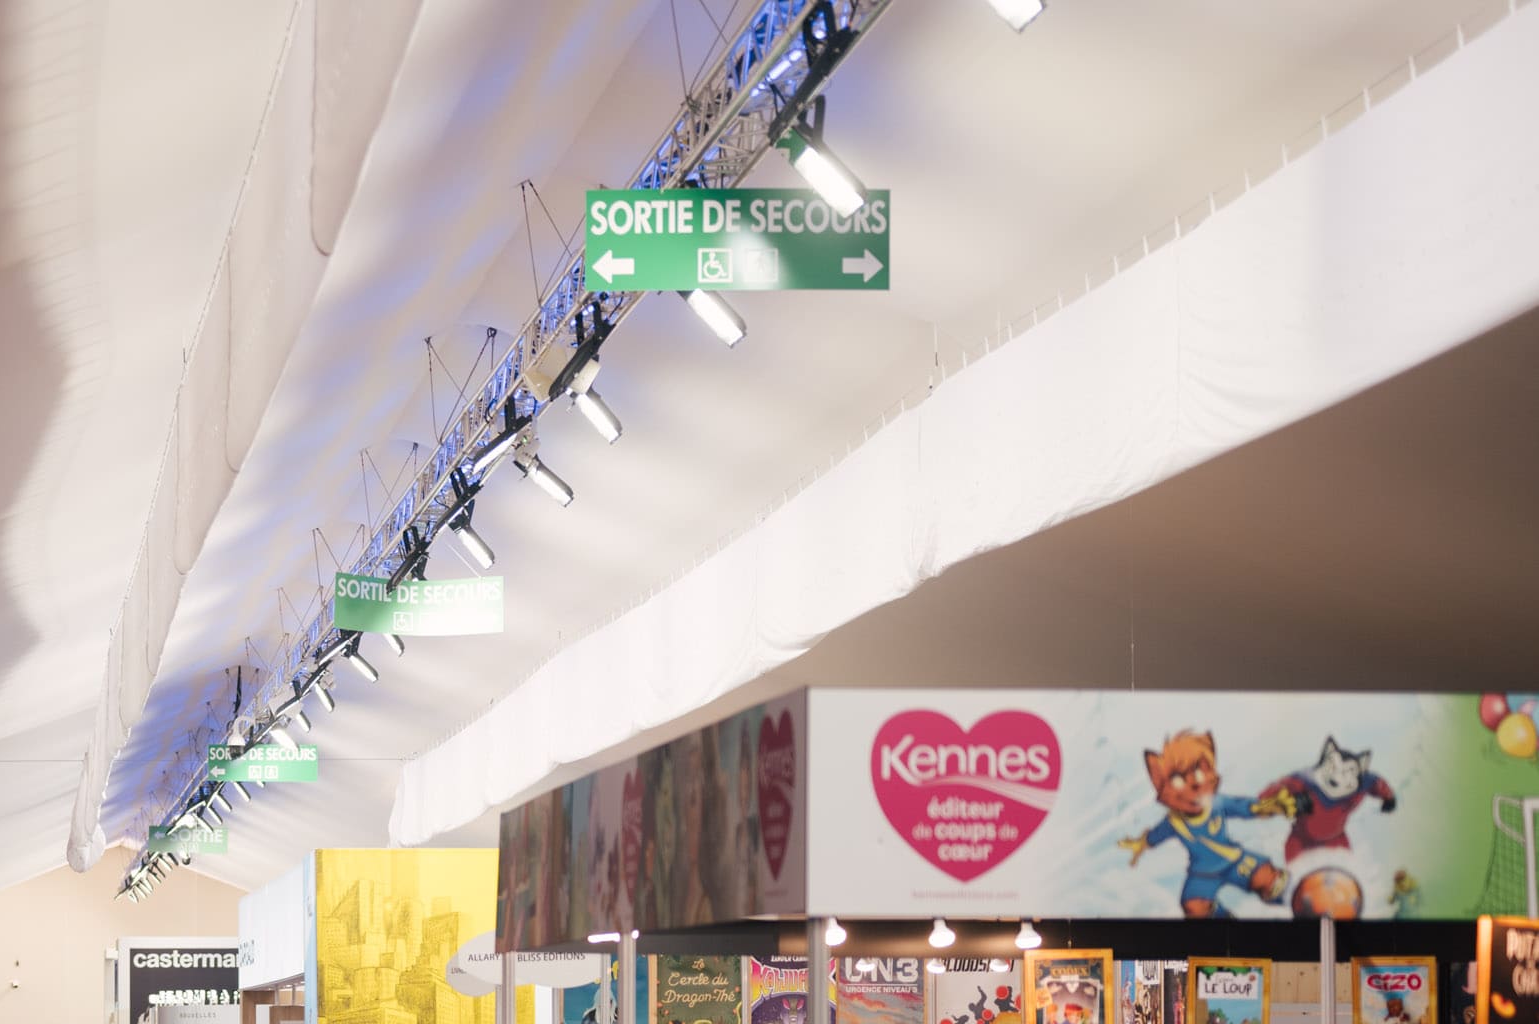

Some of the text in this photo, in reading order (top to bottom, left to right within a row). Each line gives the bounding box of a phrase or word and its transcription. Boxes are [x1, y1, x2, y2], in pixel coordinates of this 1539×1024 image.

[591, 199, 887, 235] SORTIE DE SECOURS
[397, 585, 419, 603] DE
[423, 582, 501, 605] SECOURS
[249, 748, 264, 760] DE
[266, 748, 316, 760] SECOURS
[881, 734, 1050, 786] Kennes
[927, 797, 1004, 819] éditeur
[170, 829, 223, 842] SORTIE
[912, 823, 1018, 843] de coups de
[937, 844, 993, 861] cœur
[133, 950, 239, 968] casterma
[468, 953, 500, 962] ALLARY
[517, 952, 586, 962] BLISS EDITIONS
[668, 972, 729, 987] Cercle du
[664, 987, 735, 1004] Dragon-Thé
[1205, 982, 1252, 995] LE LOUP
